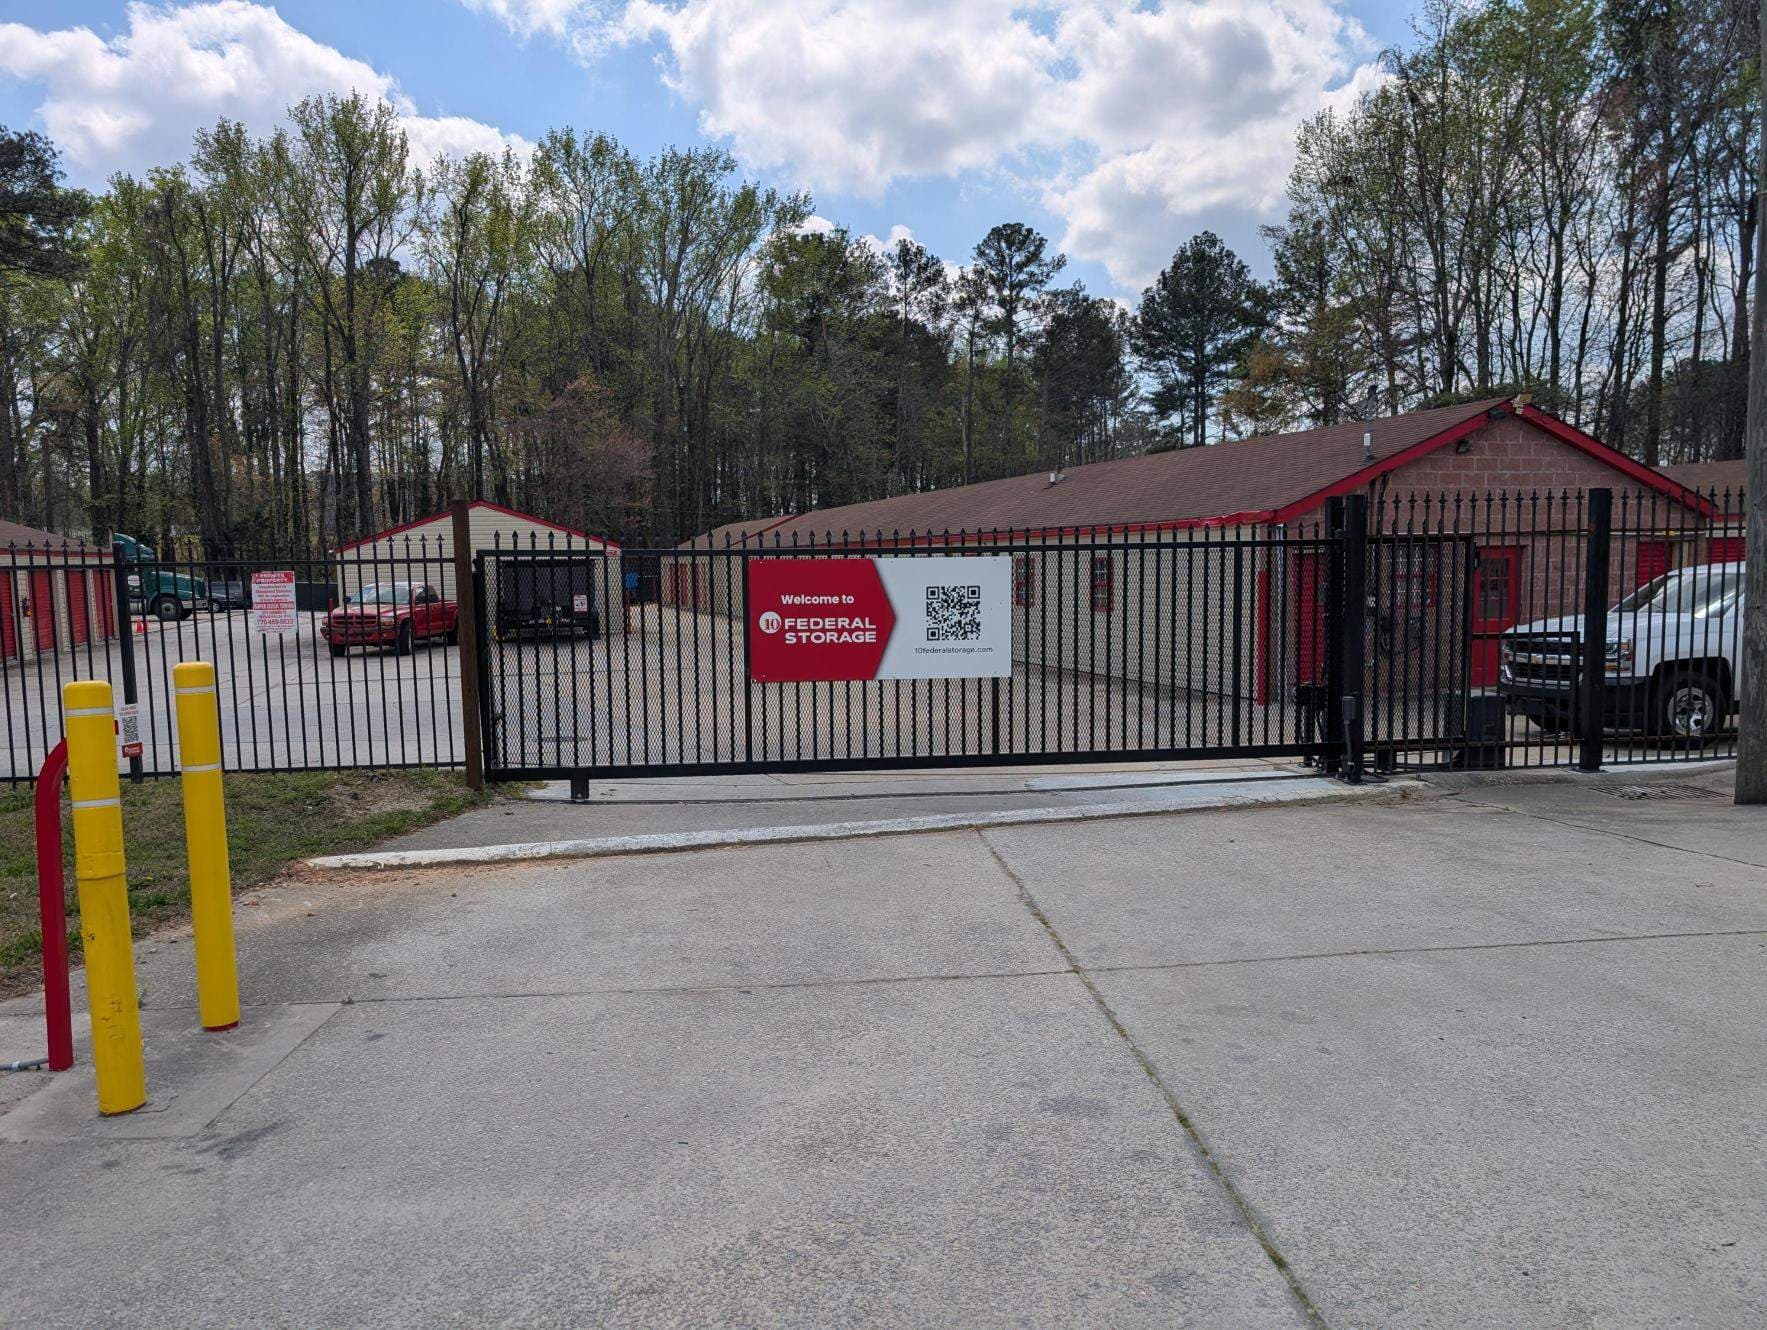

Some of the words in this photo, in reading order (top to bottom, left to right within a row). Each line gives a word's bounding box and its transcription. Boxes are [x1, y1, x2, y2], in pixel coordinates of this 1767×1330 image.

[781, 594, 840, 605] Welcome
[841, 594, 855, 605] to
[784, 616, 877, 630] FEDERAL
[784, 631, 877, 644] STORAGE
[914, 645, 994, 655] 10federalstorage.com
